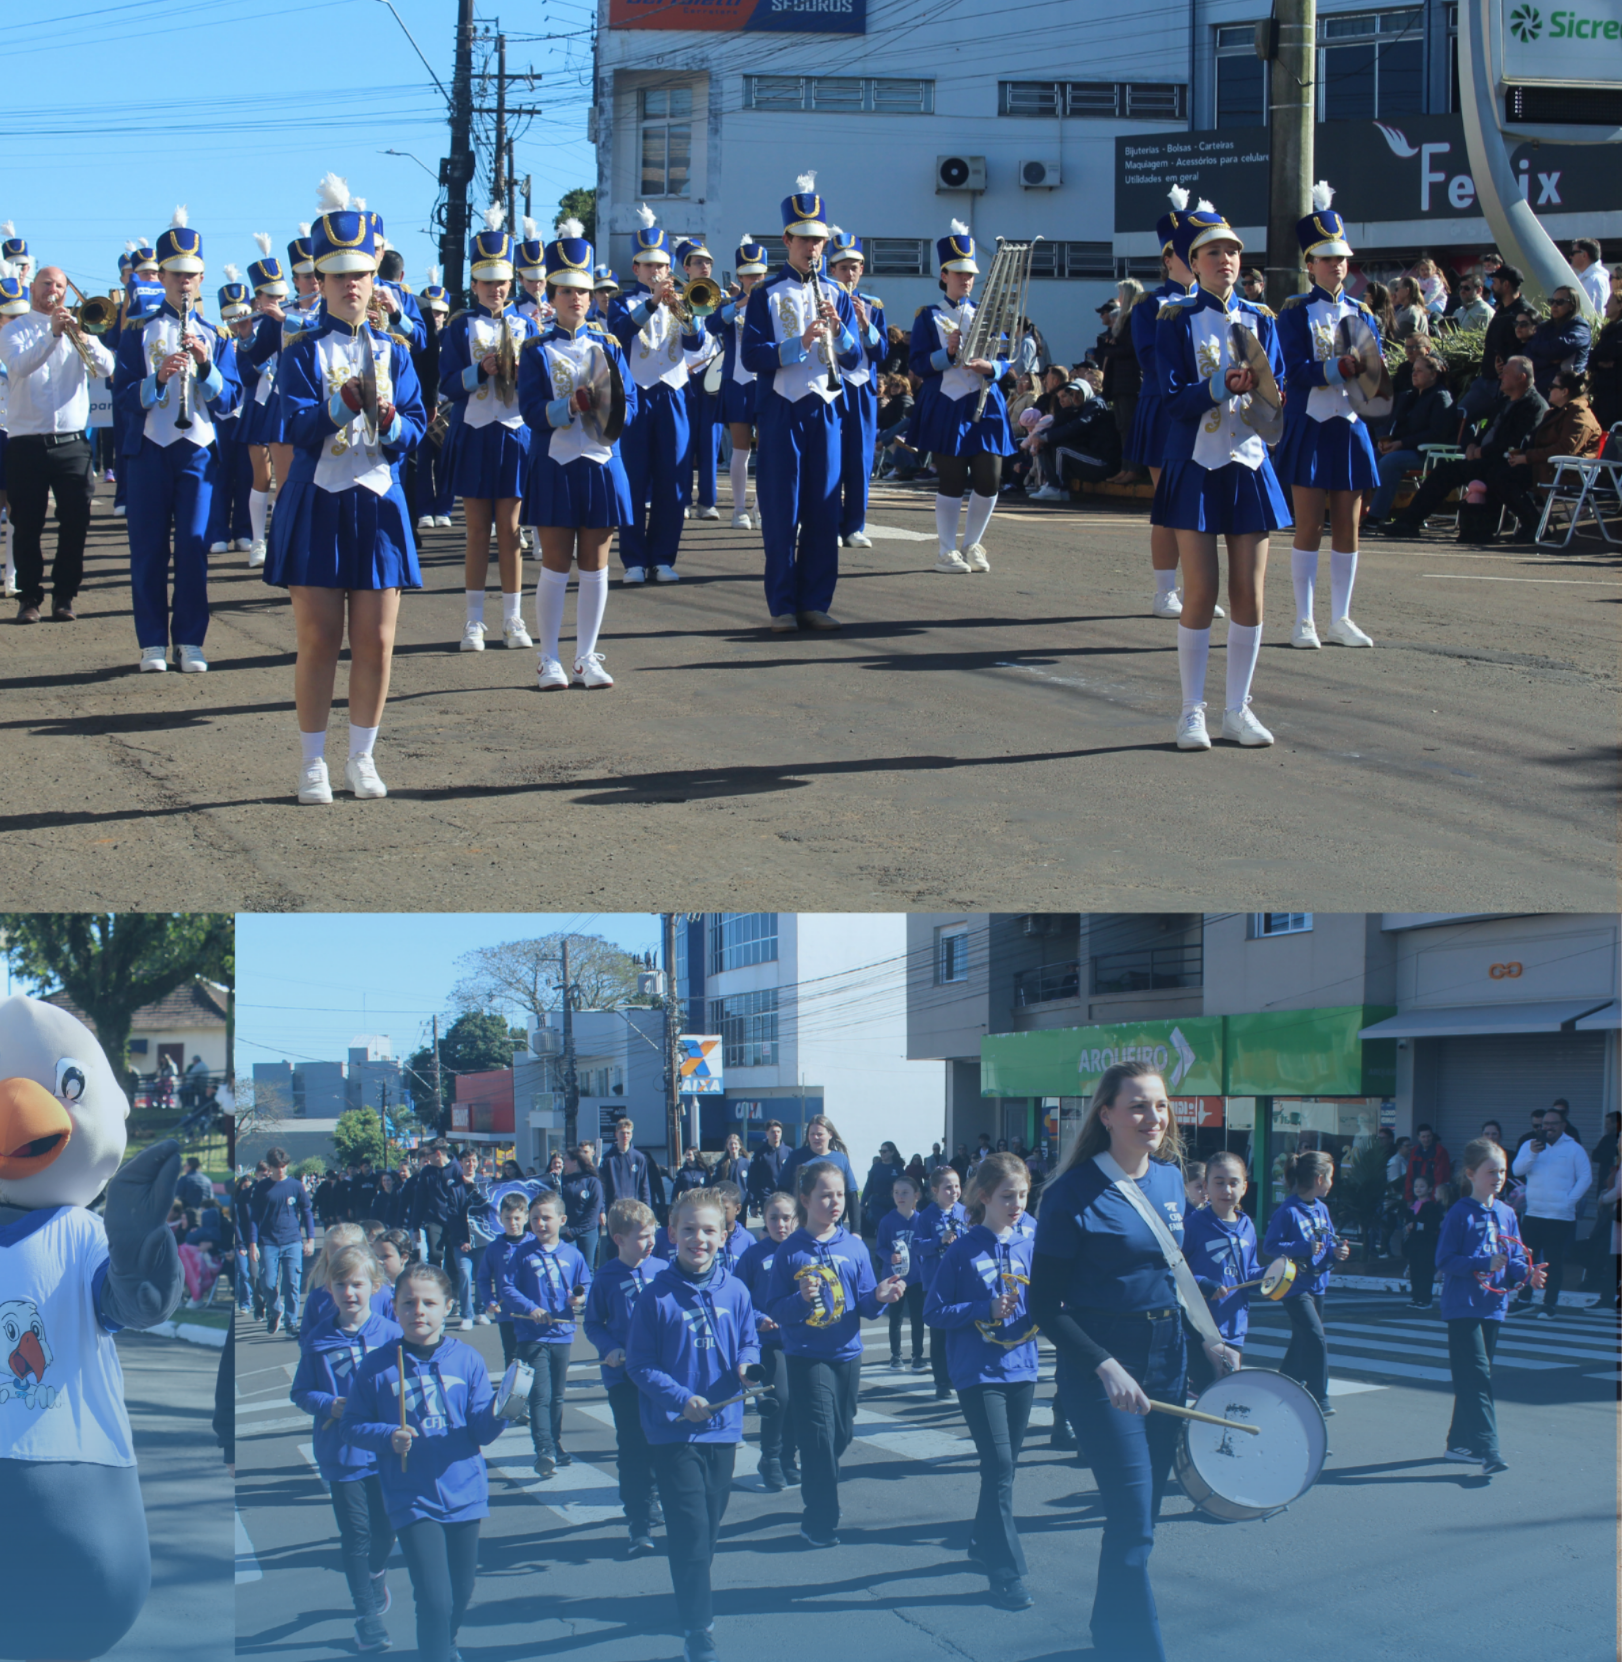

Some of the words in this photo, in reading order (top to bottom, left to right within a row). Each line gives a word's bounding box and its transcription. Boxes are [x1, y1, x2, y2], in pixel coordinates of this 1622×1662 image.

[1125, 146, 1159, 157] Bijuterias
[1167, 144, 1192, 153] Bolsas
[1199, 141, 1234, 150] Carteiras
[1125, 160, 1168, 171] Maquiagem
[1176, 156, 1217, 166] Acessórios
[1220, 156, 1238, 167] para
[1125, 174, 1162, 184] Utilidades
[1179, 171, 1199, 183] geral
[1421, 142, 1562, 211] Feix
[681, 1079, 721, 1092] AIXA
